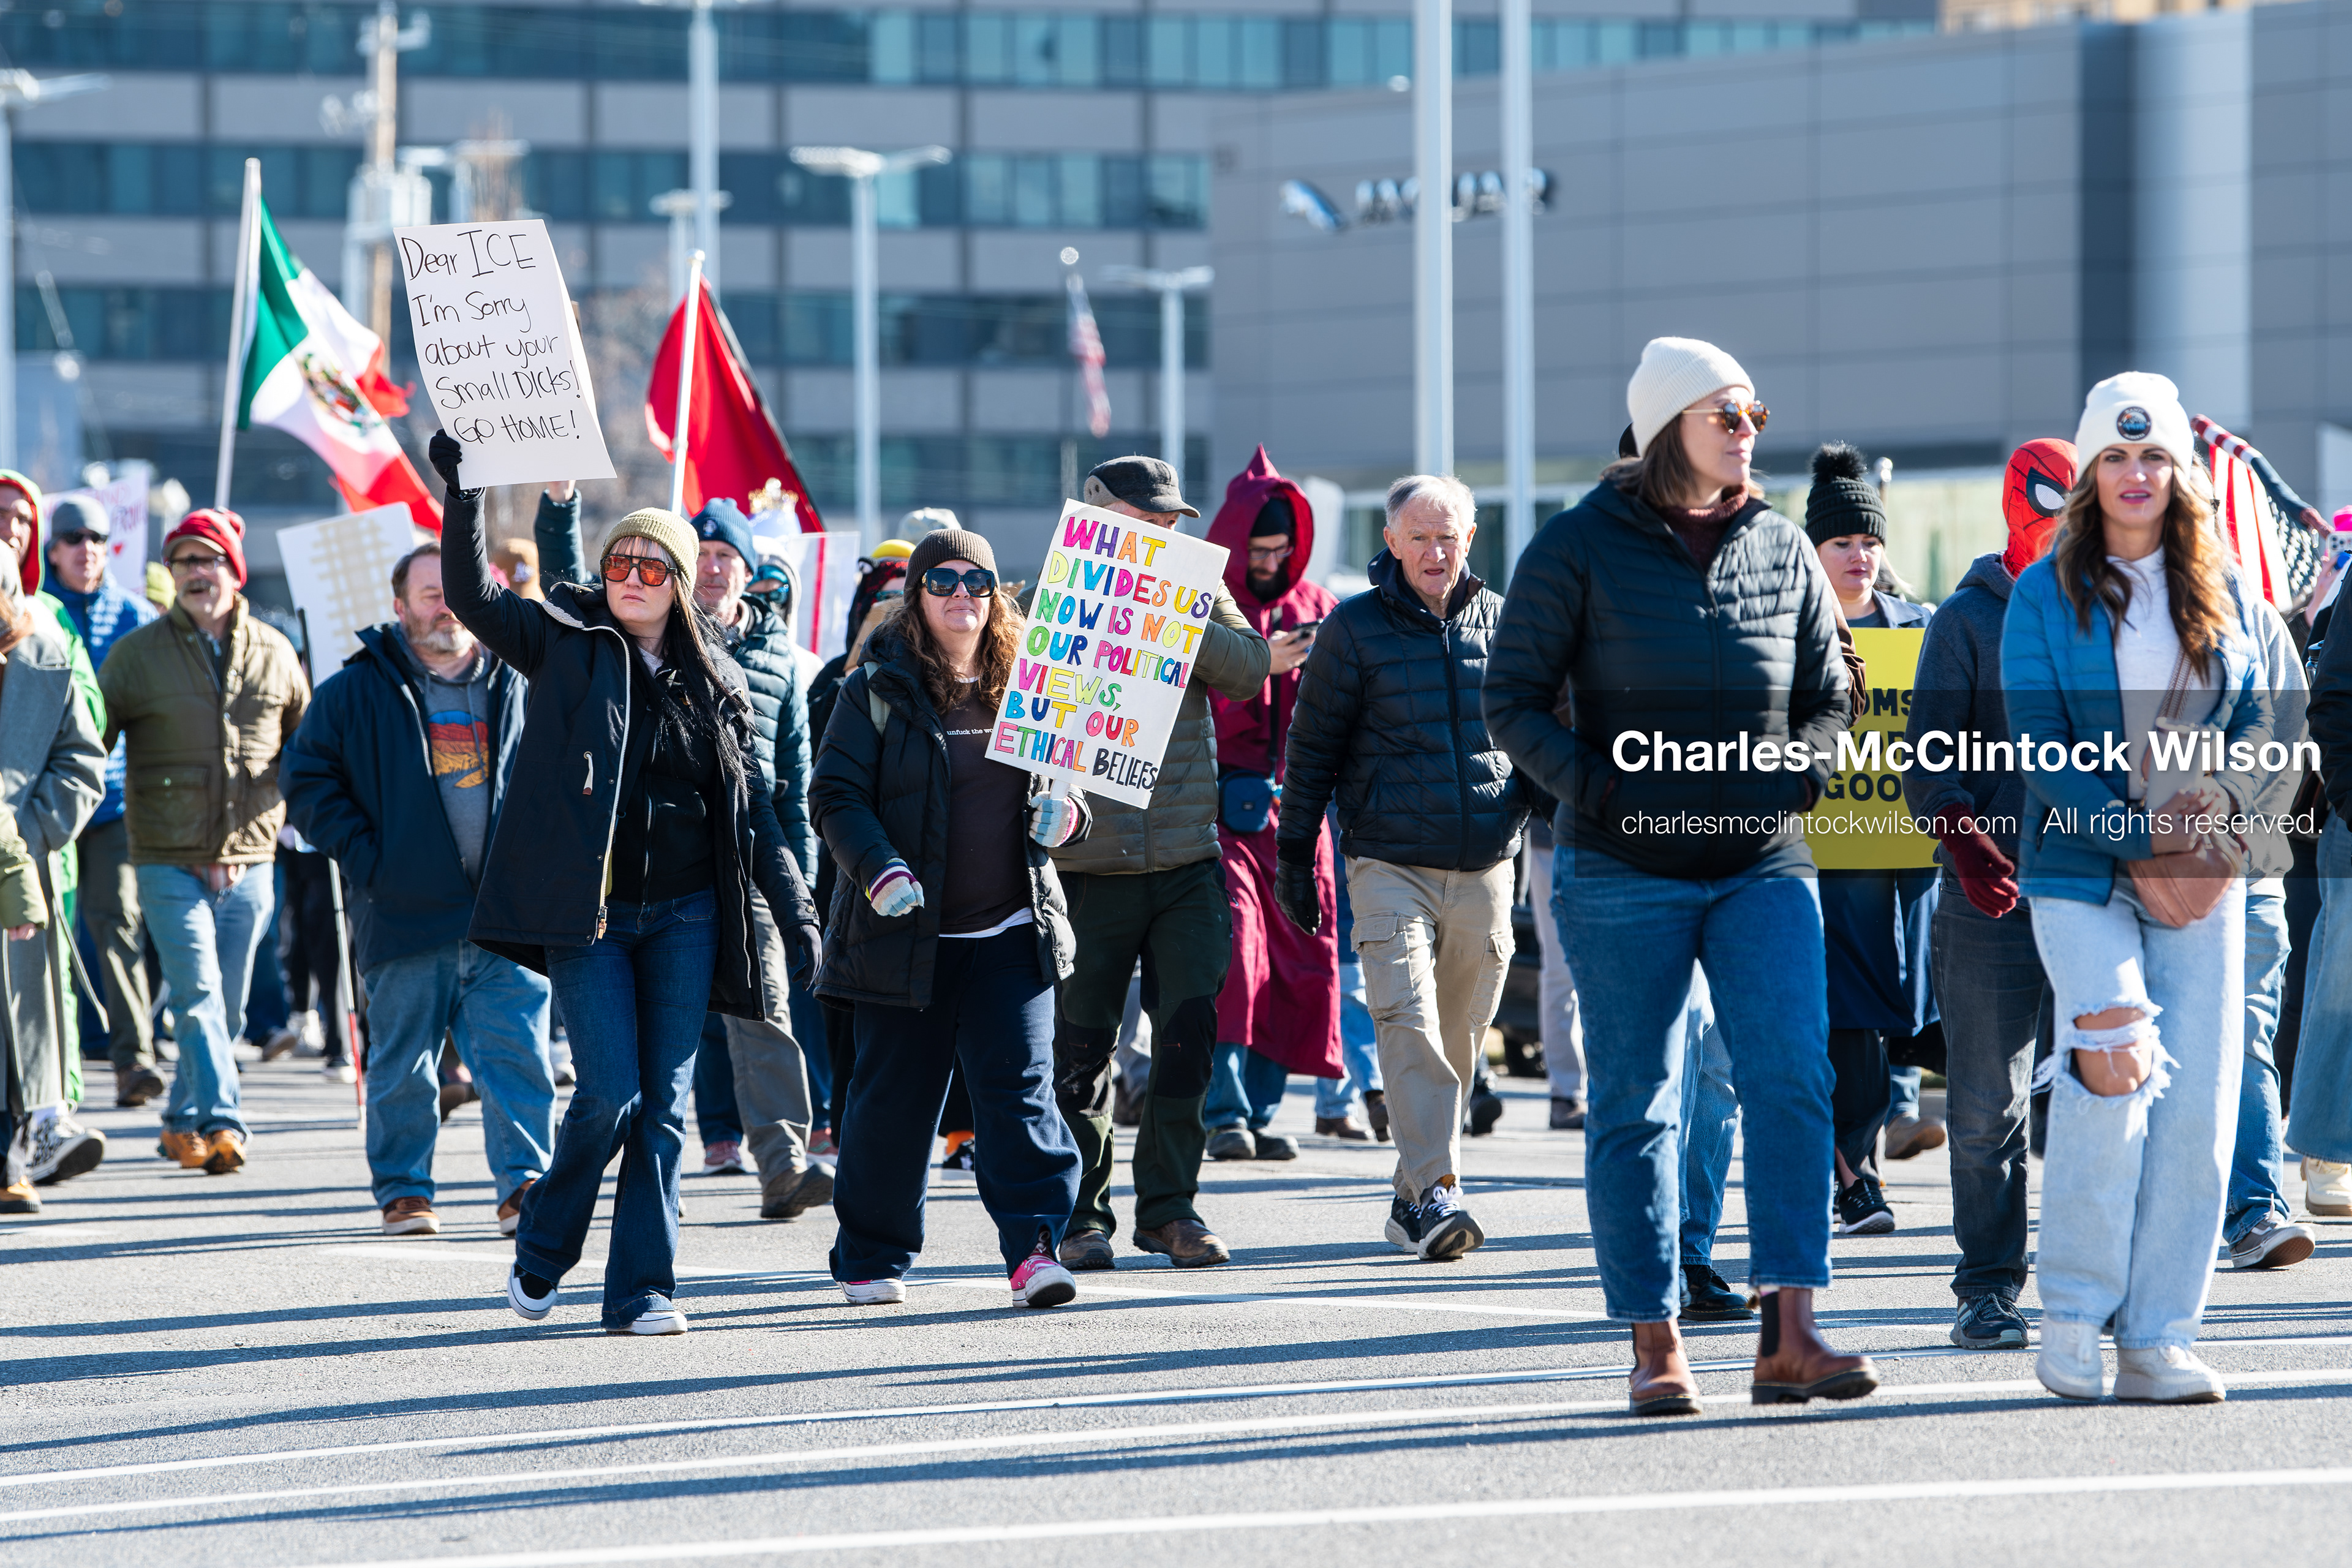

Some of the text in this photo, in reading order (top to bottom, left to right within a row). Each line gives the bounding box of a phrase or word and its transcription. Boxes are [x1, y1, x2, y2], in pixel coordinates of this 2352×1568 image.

[401, 229, 536, 281] Dear ICE
[412, 290, 532, 333] I'm Sorry
[425, 334, 558, 369] about your
[435, 371, 510, 409] Small
[453, 417, 494, 444] GO
[1063, 516, 1167, 567] WHAT
[1047, 551, 1212, 619] DIVIDES US
[1035, 588, 1204, 654] NOW IS NOT
[1027, 625, 1189, 688] OUR POLITICAL
[1019, 658, 1122, 712] VIEWS,
[1005, 690, 1139, 747] BUT OUR
[995, 722, 1087, 772] ETHICAL
